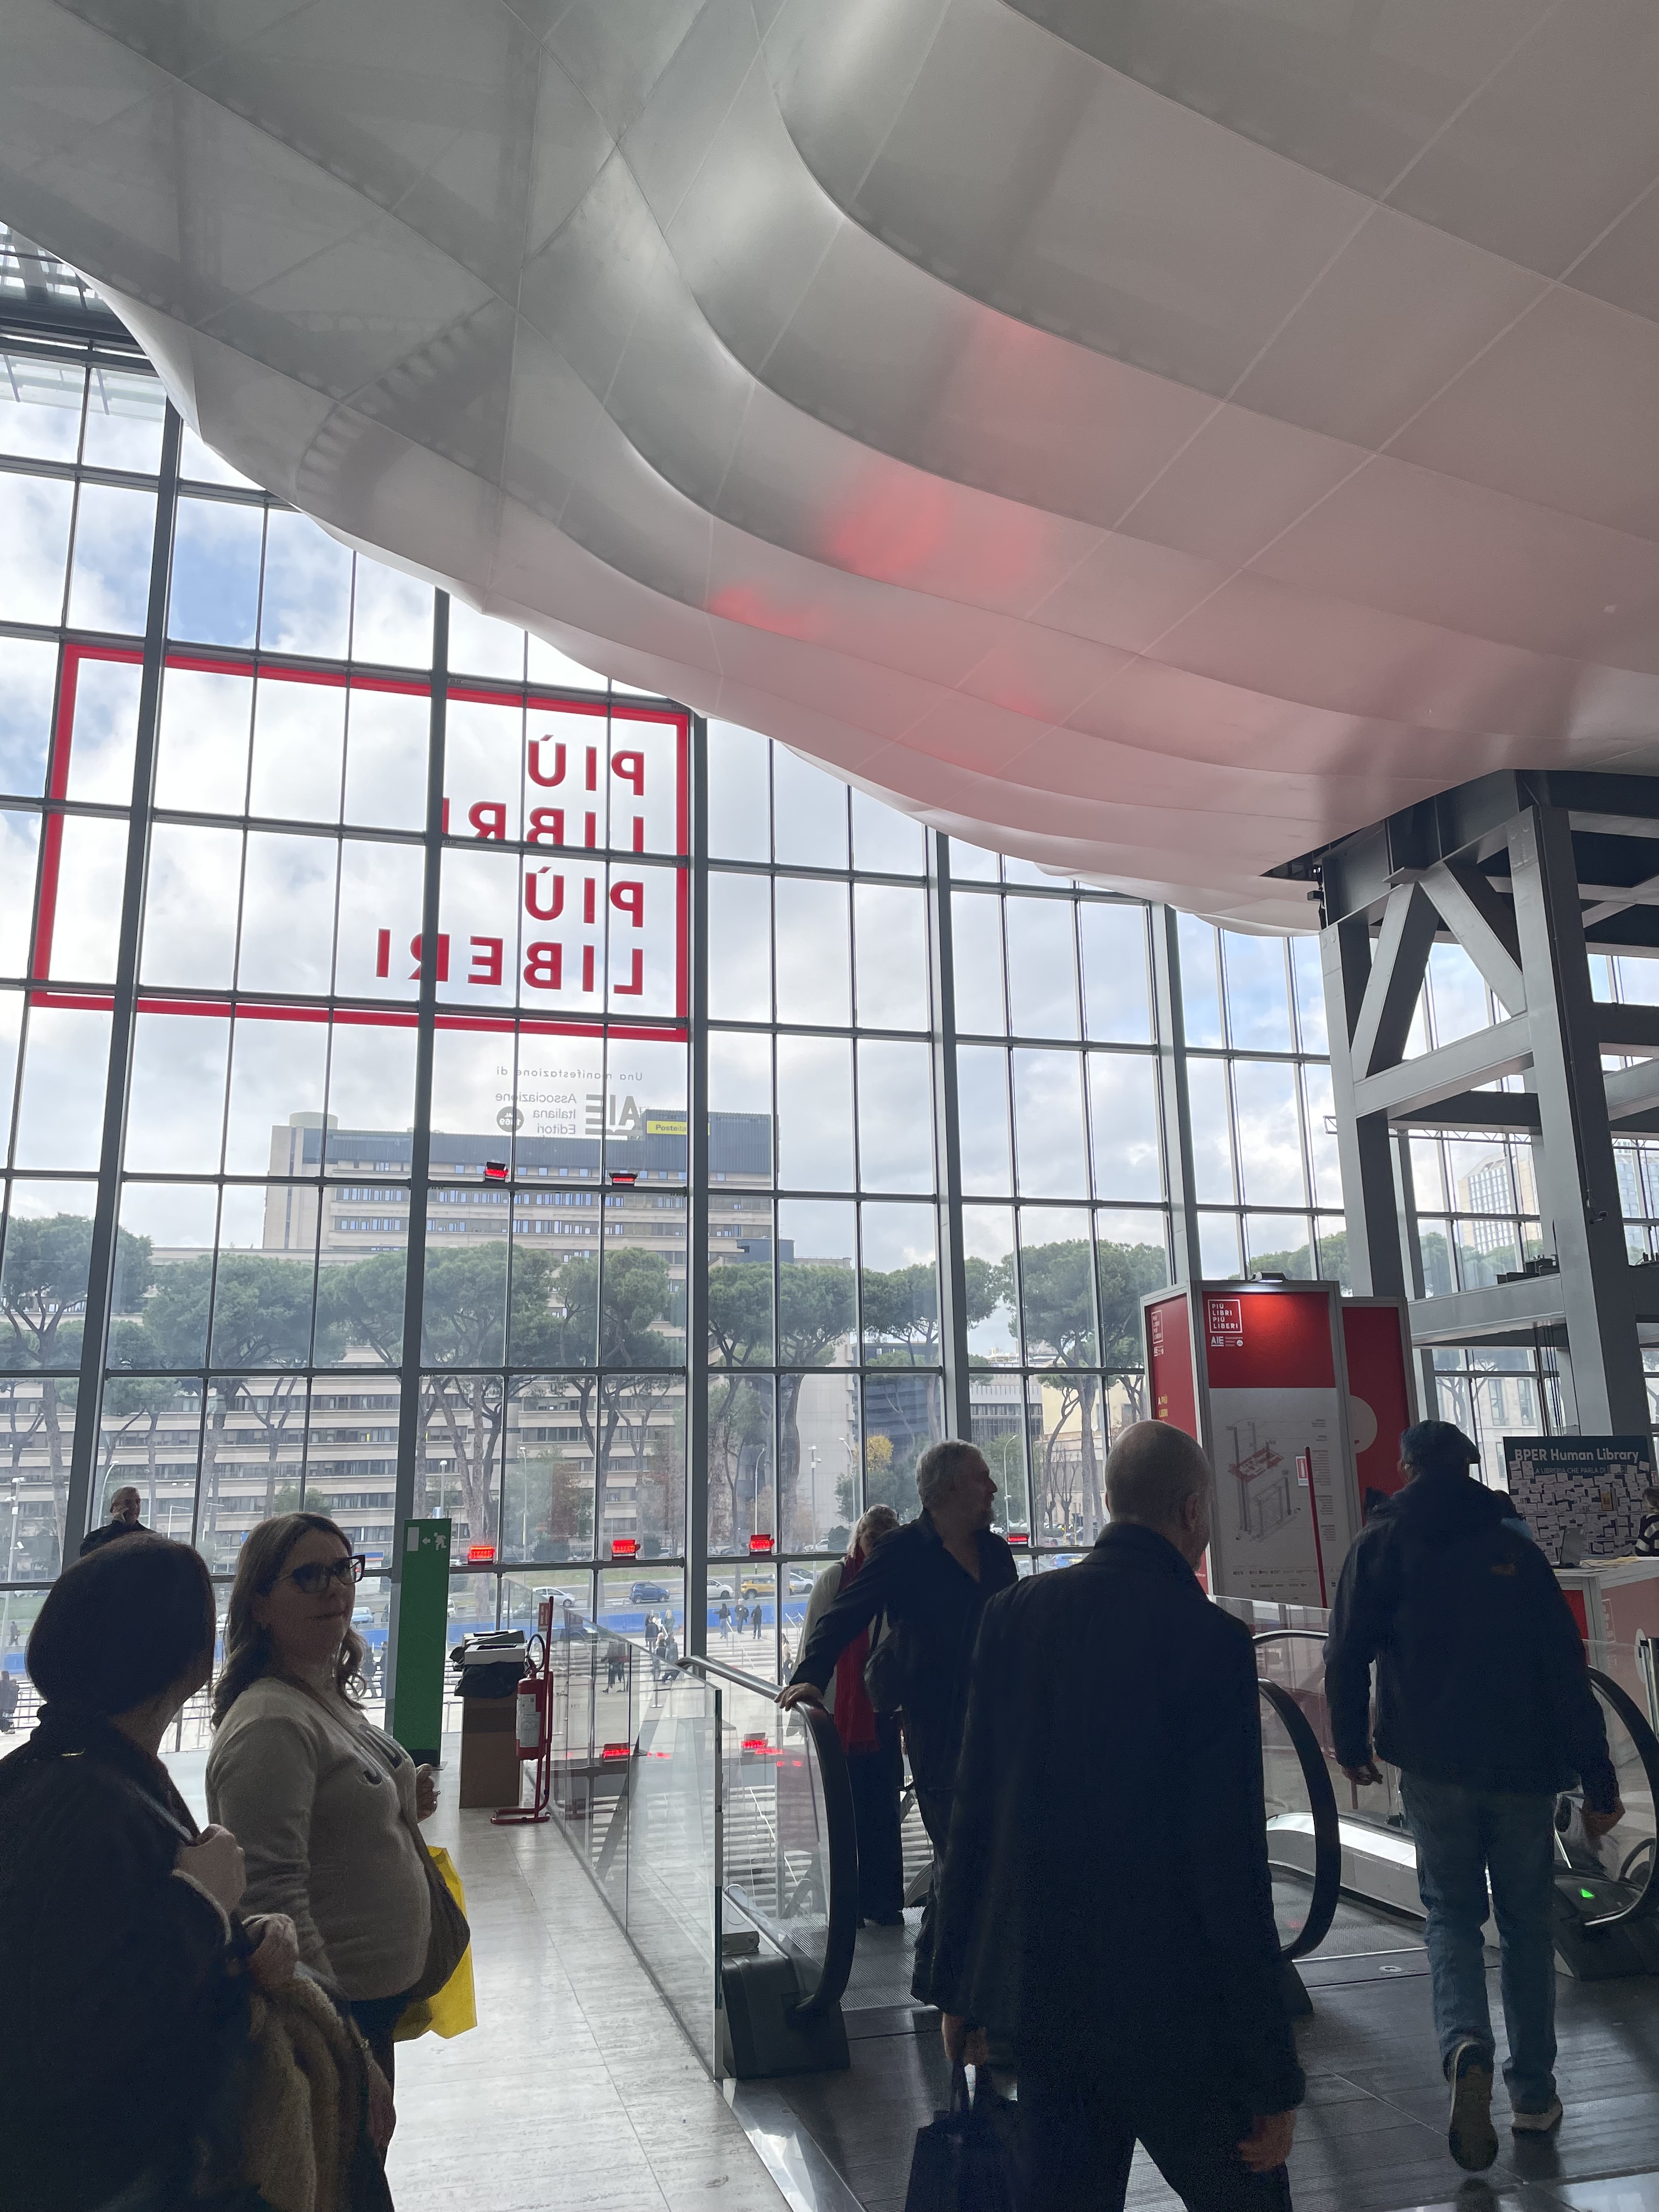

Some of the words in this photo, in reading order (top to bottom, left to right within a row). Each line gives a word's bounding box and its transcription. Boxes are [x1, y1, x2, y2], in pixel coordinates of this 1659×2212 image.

[1211, 1336, 1224, 1344] AIE
[1514, 1448, 1548, 1462] BPER
[1550, 1448, 1594, 1461] Human
[1596, 1447, 1639, 1464] Library
